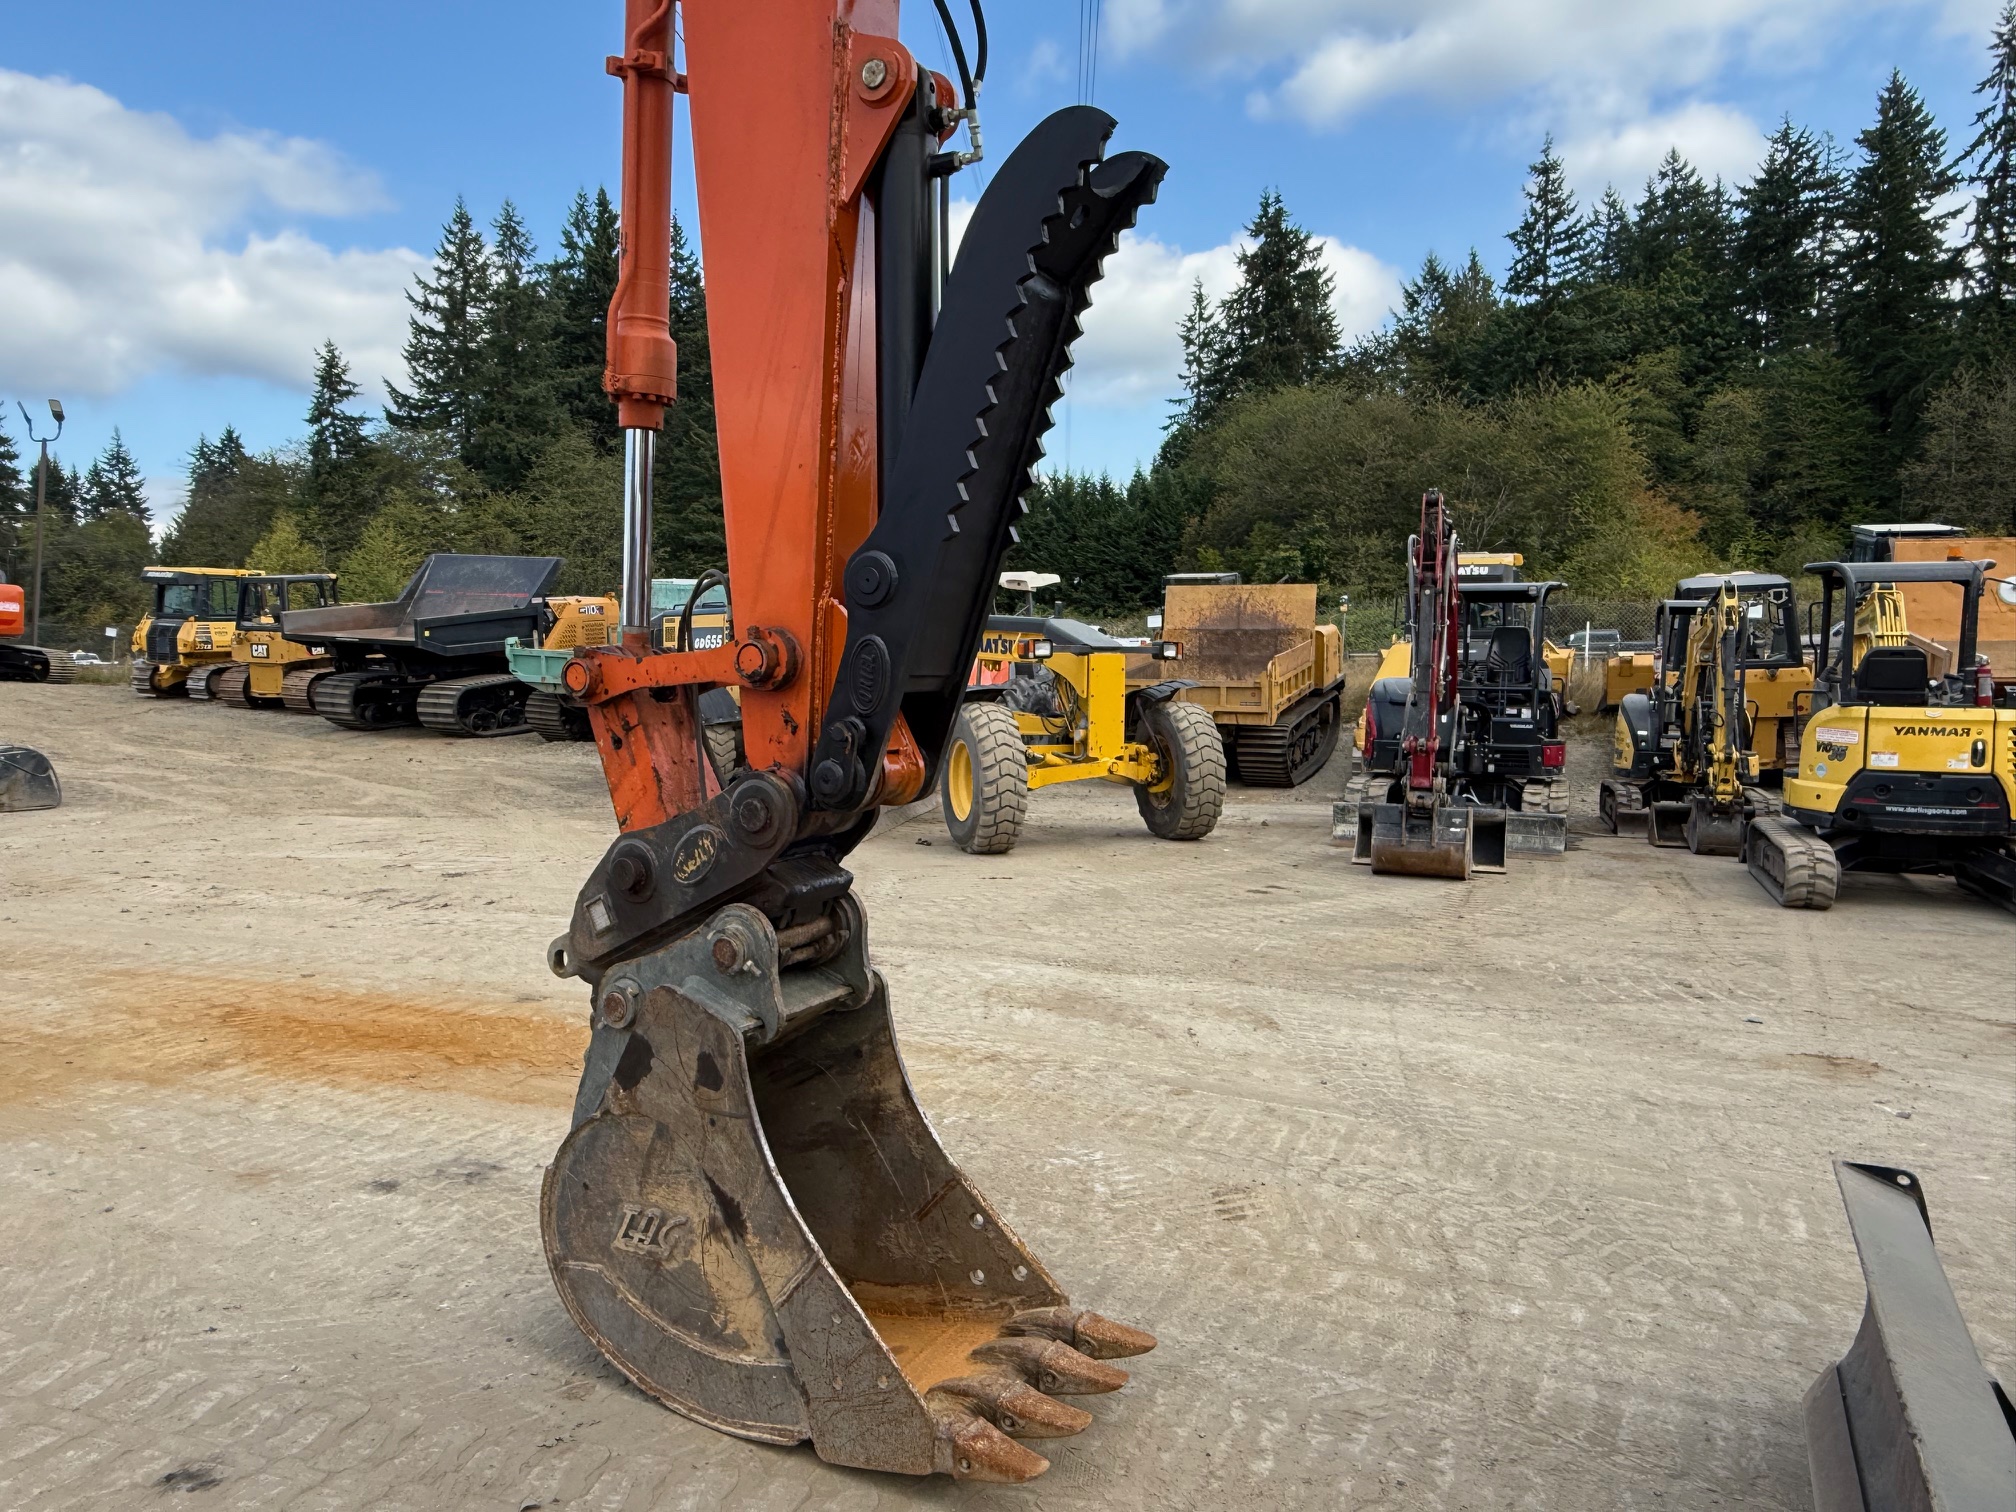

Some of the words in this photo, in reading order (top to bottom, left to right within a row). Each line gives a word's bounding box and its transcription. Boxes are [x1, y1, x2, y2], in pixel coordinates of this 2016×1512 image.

[1458, 565, 1489, 575] ATSU
[694, 634, 723, 649] GD655
[252, 644, 268, 657] CAT
[1893, 726, 1971, 737] YANMAR
